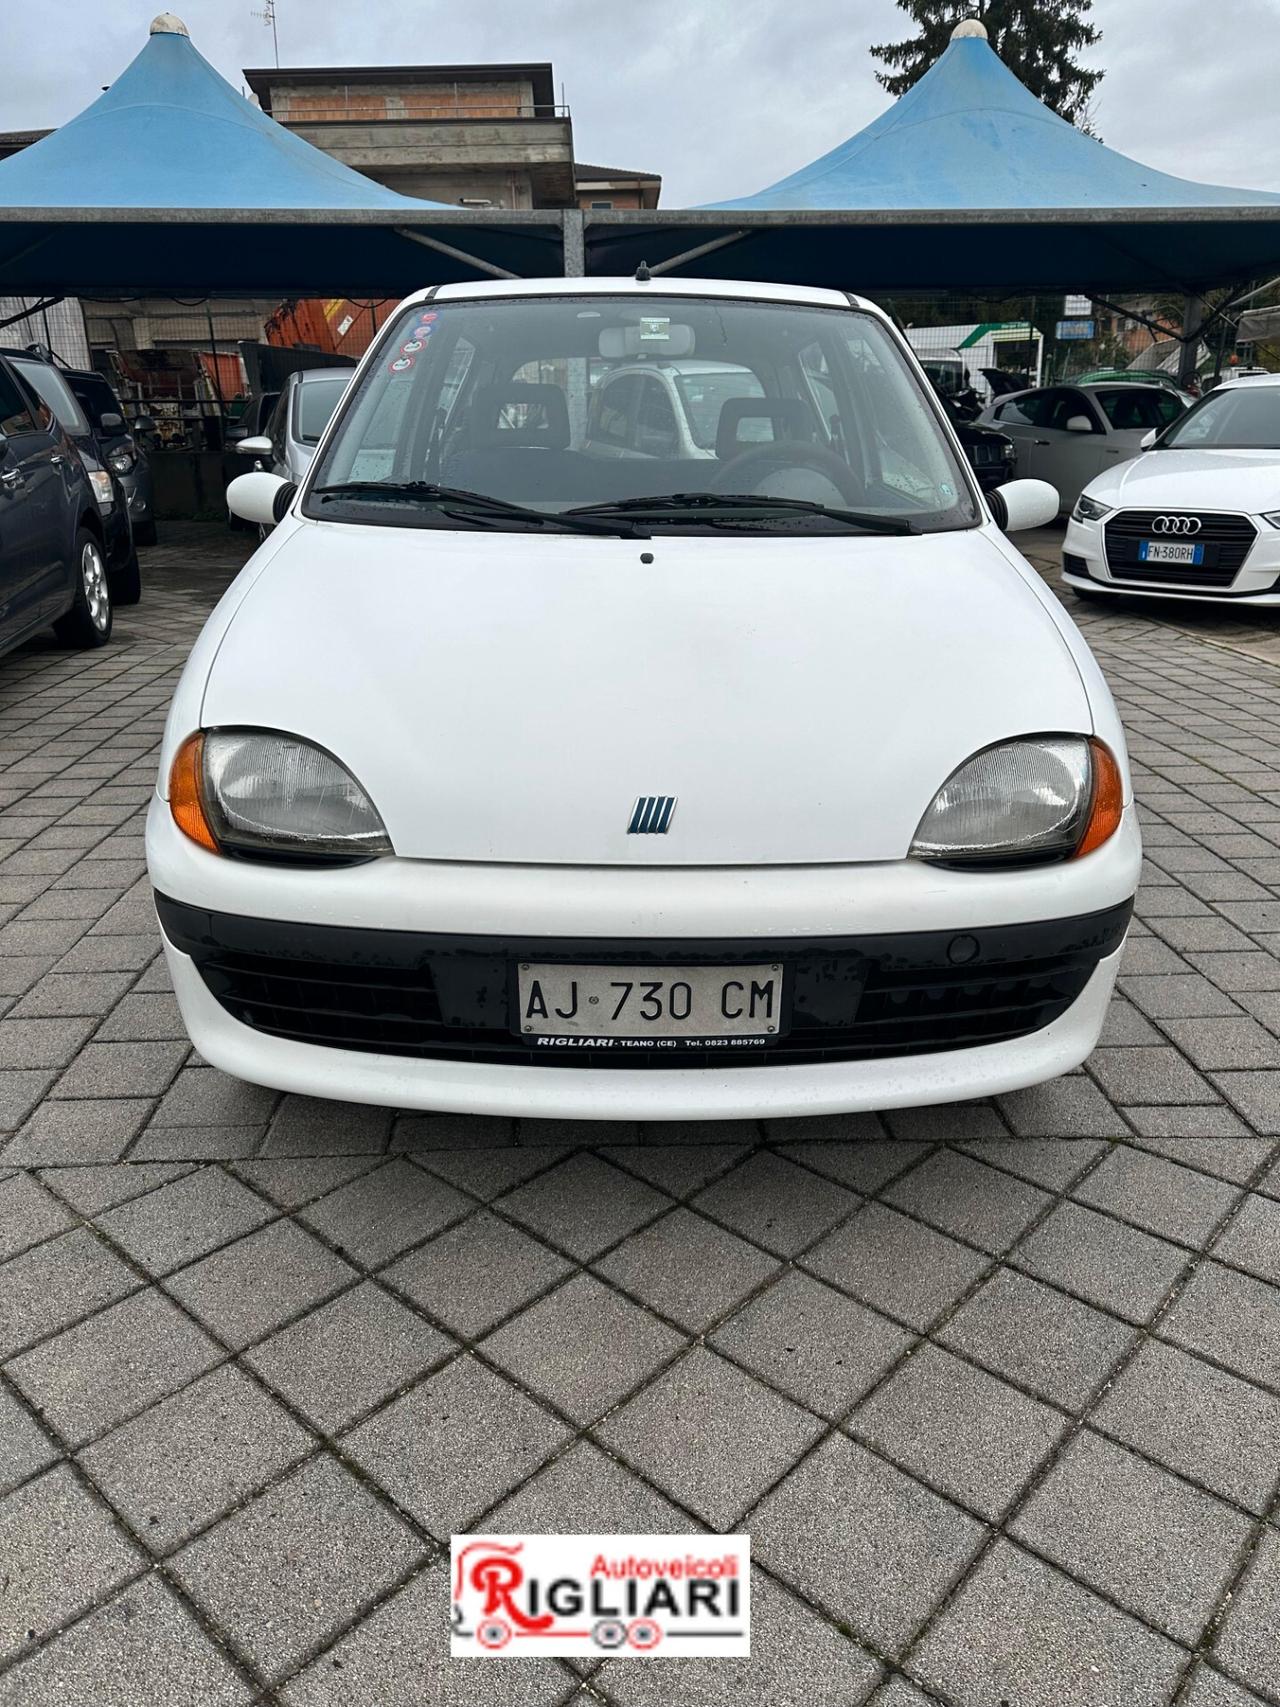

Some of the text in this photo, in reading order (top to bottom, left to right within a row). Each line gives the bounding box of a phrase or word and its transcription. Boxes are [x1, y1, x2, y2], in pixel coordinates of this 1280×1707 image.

[525, 980, 774, 1020] AJ 730 CM
[656, 1040, 677, 1048] (CE)
[730, 1038, 765, 1046] 885769
